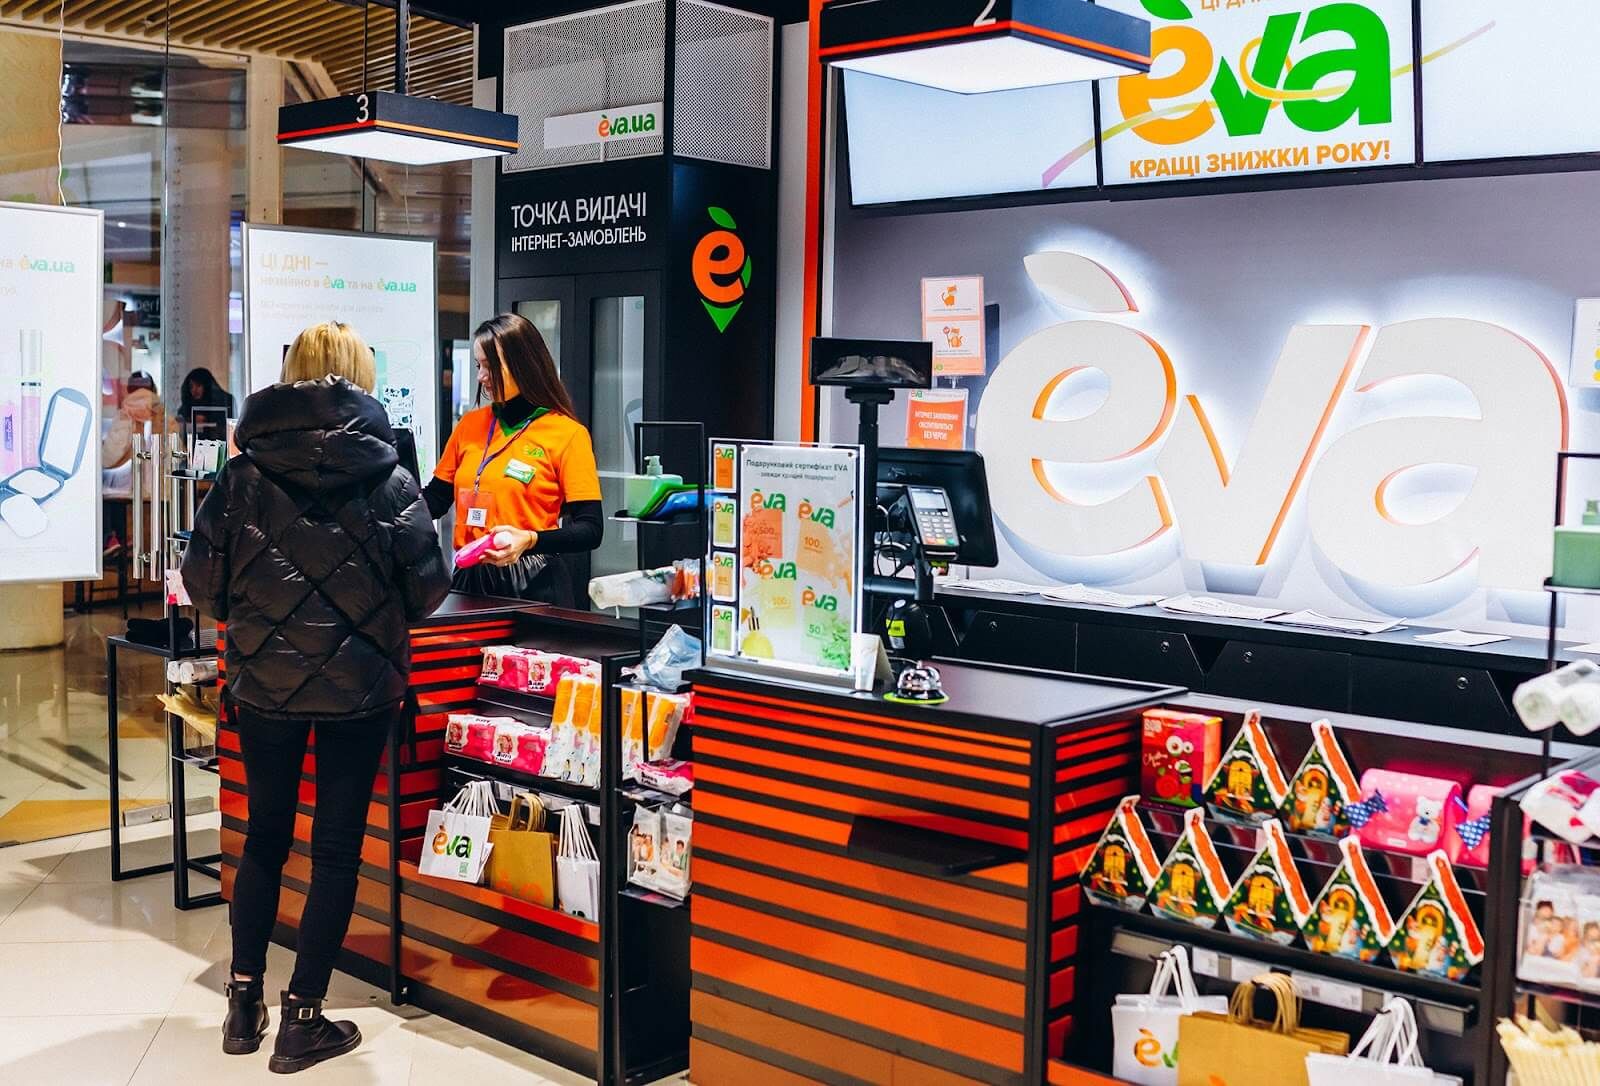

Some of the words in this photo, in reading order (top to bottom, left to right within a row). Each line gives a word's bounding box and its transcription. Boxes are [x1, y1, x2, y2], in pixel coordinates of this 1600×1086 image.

[355, 94, 369, 124] 3
[1129, 155, 1200, 178] КРАЩІ
[1206, 147, 1309, 173] ЗНИЖКИ
[1316, 140, 1391, 164] РОКУ!
[511, 200, 571, 228] ТОЧКА
[575, 192, 646, 224] ВИДАЧІ
[511, 226, 647, 252] ІНТЕРНЕТ-ЗАМОВЛЕНЬ
[261, 253, 277, 270] ЦІ
[281, 255, 311, 272] ДНІ
[834, 463, 848, 472] EVA
